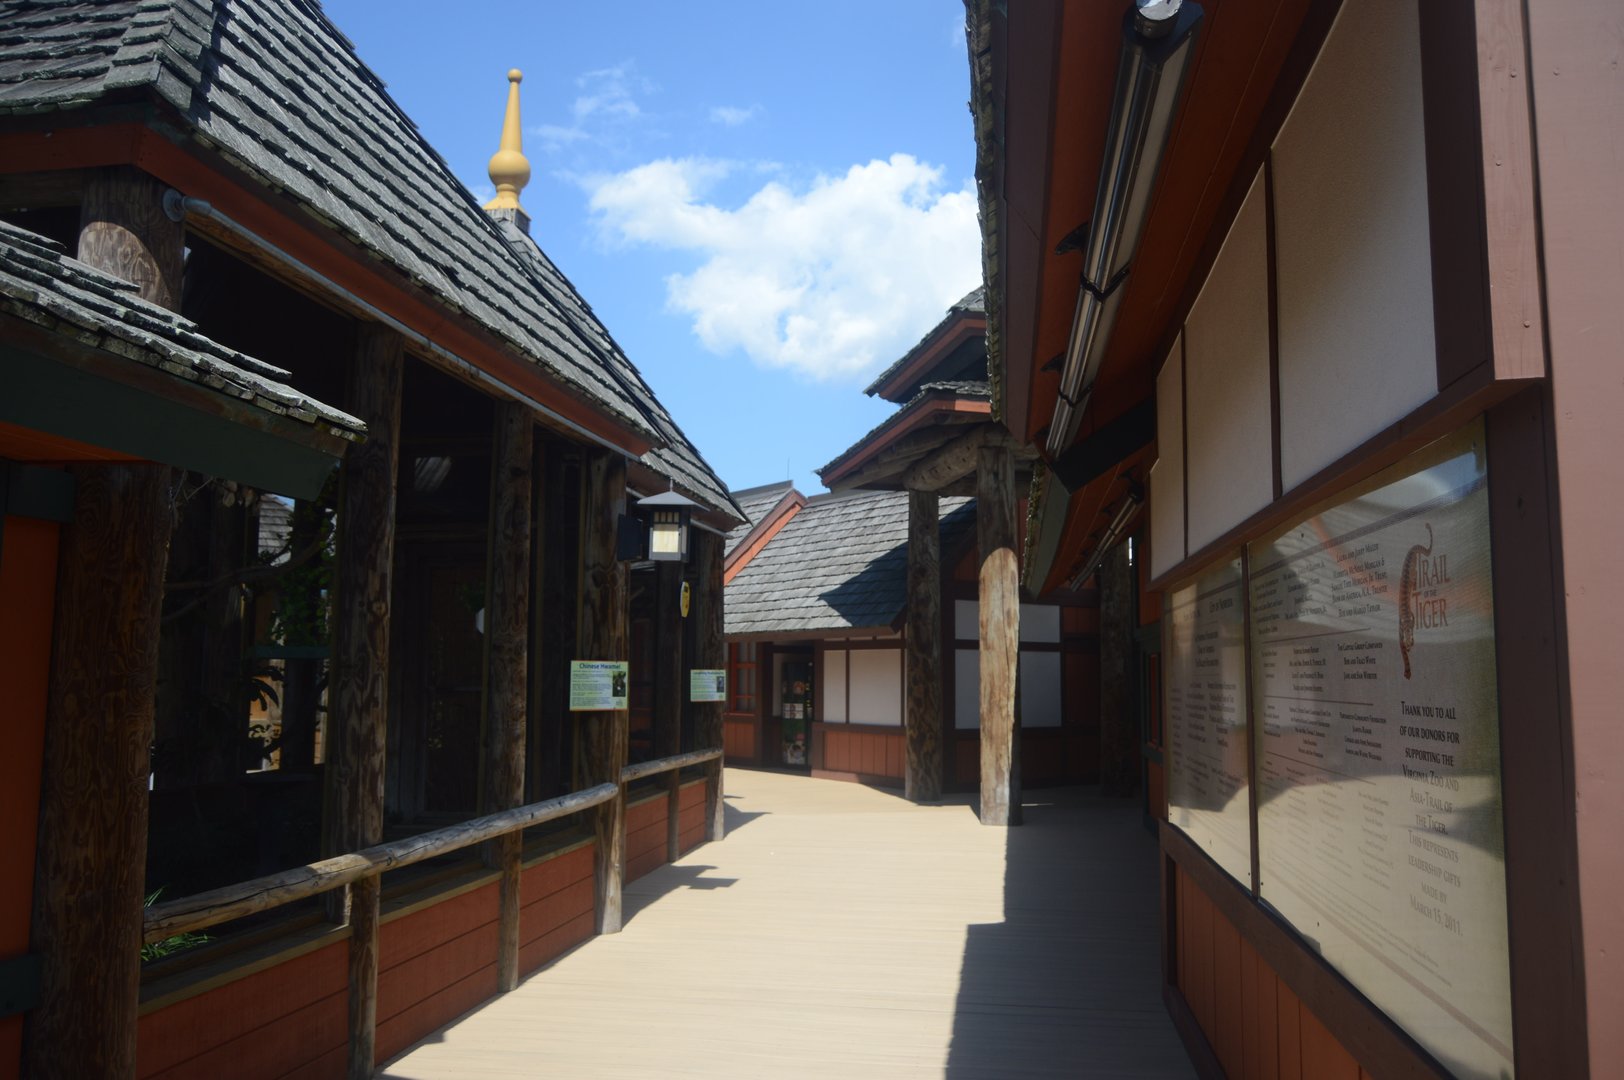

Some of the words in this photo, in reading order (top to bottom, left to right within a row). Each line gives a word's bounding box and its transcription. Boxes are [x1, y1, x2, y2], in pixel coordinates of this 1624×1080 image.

[1416, 551, 1450, 589] TRAIL
[1412, 592, 1449, 630] TIGER
[1401, 700, 1421, 716] THANK
[1422, 705, 1434, 718] YOU
[1435, 706, 1444, 719] TO
[1445, 706, 1456, 720] ALL
[1400, 725, 1407, 736] OF
[1408, 726, 1420, 738] OUR
[1421, 728, 1445, 742] DONORS
[1447, 731, 1460, 744] FOR
[1405, 747, 1440, 764] SUPPORTING
[1441, 753, 1454, 767] THE
[1429, 770, 1444, 788] ZOO
[1445, 778, 1459, 792] AND
[1444, 800, 1453, 814] OF
[1415, 814, 1426, 829] THE
[1408, 829, 1422, 848] THIS
[1423, 839, 1459, 863] REPRESENTS
[1408, 854, 1442, 879] LEADERSHIP
[1443, 869, 1461, 888] GIFTS
[1421, 881, 1438, 900] MADE
[1439, 890, 1448, 904] BY
[1409, 893, 1432, 920] MARCH
